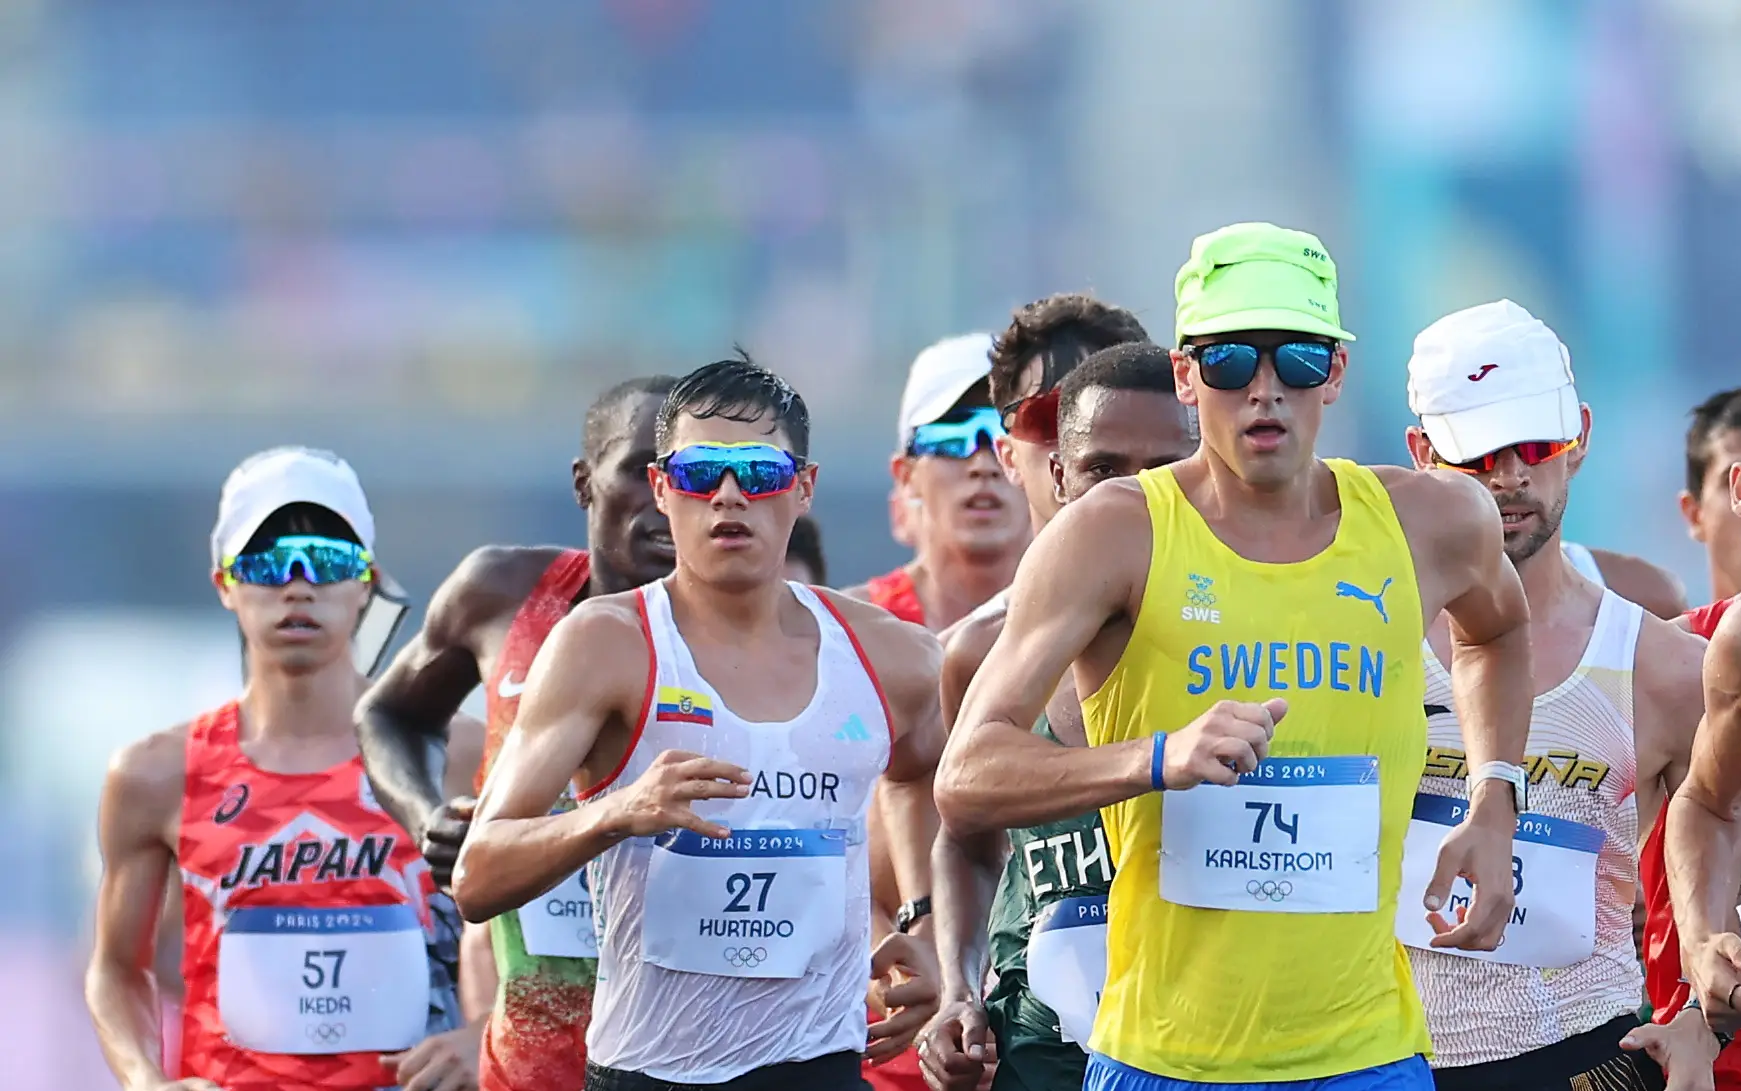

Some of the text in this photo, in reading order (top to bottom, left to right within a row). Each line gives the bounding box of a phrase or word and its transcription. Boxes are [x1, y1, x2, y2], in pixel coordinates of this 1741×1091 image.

[1303, 247, 1327, 262] SWE
[1180, 605, 1222, 624] SWE
[1186, 640, 1385, 698] SWEDEN
[1281, 764, 1326, 779] 2024
[1244, 801, 1299, 845] 74
[758, 836, 804, 850] 2024
[220, 835, 396, 891] JAPAN
[1205, 848, 1333, 872] KARLSTROM
[722, 871, 778, 914] 27
[325, 912, 375, 929] 2024
[700, 918, 795, 938] HURTADO
[301, 948, 348, 990] 57
[298, 995, 352, 1015] IKEDA
